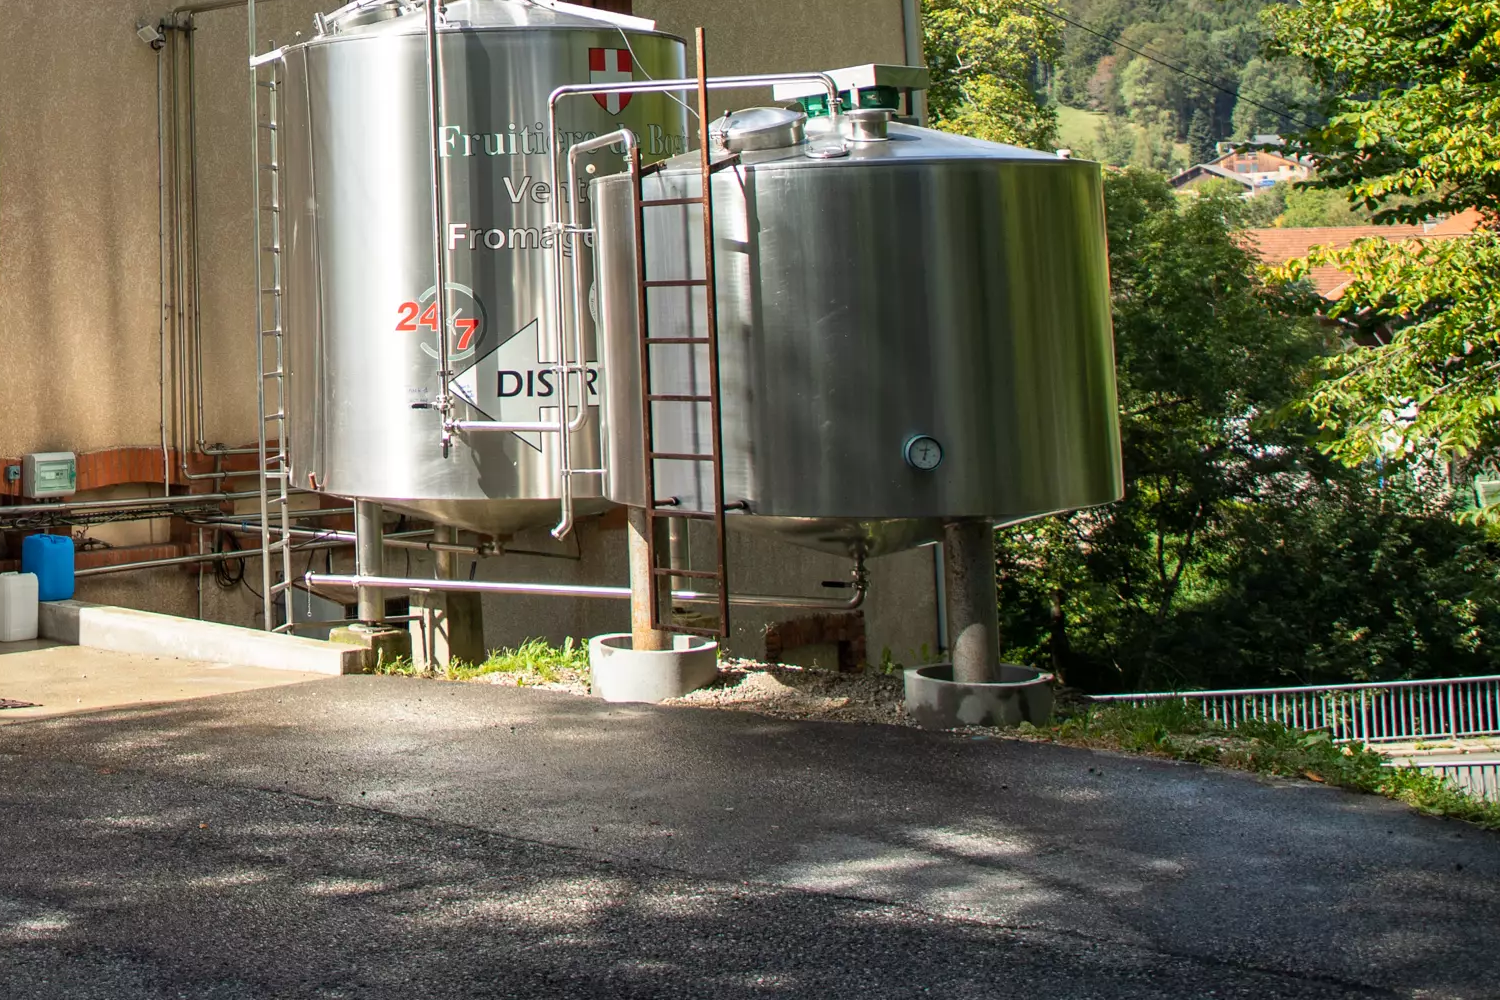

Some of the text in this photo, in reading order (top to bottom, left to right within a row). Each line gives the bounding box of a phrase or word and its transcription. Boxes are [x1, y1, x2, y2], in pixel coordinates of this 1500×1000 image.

[502, 175, 591, 204] Vent
[395, 301, 438, 332] 24
[497, 369, 598, 398] DISR
